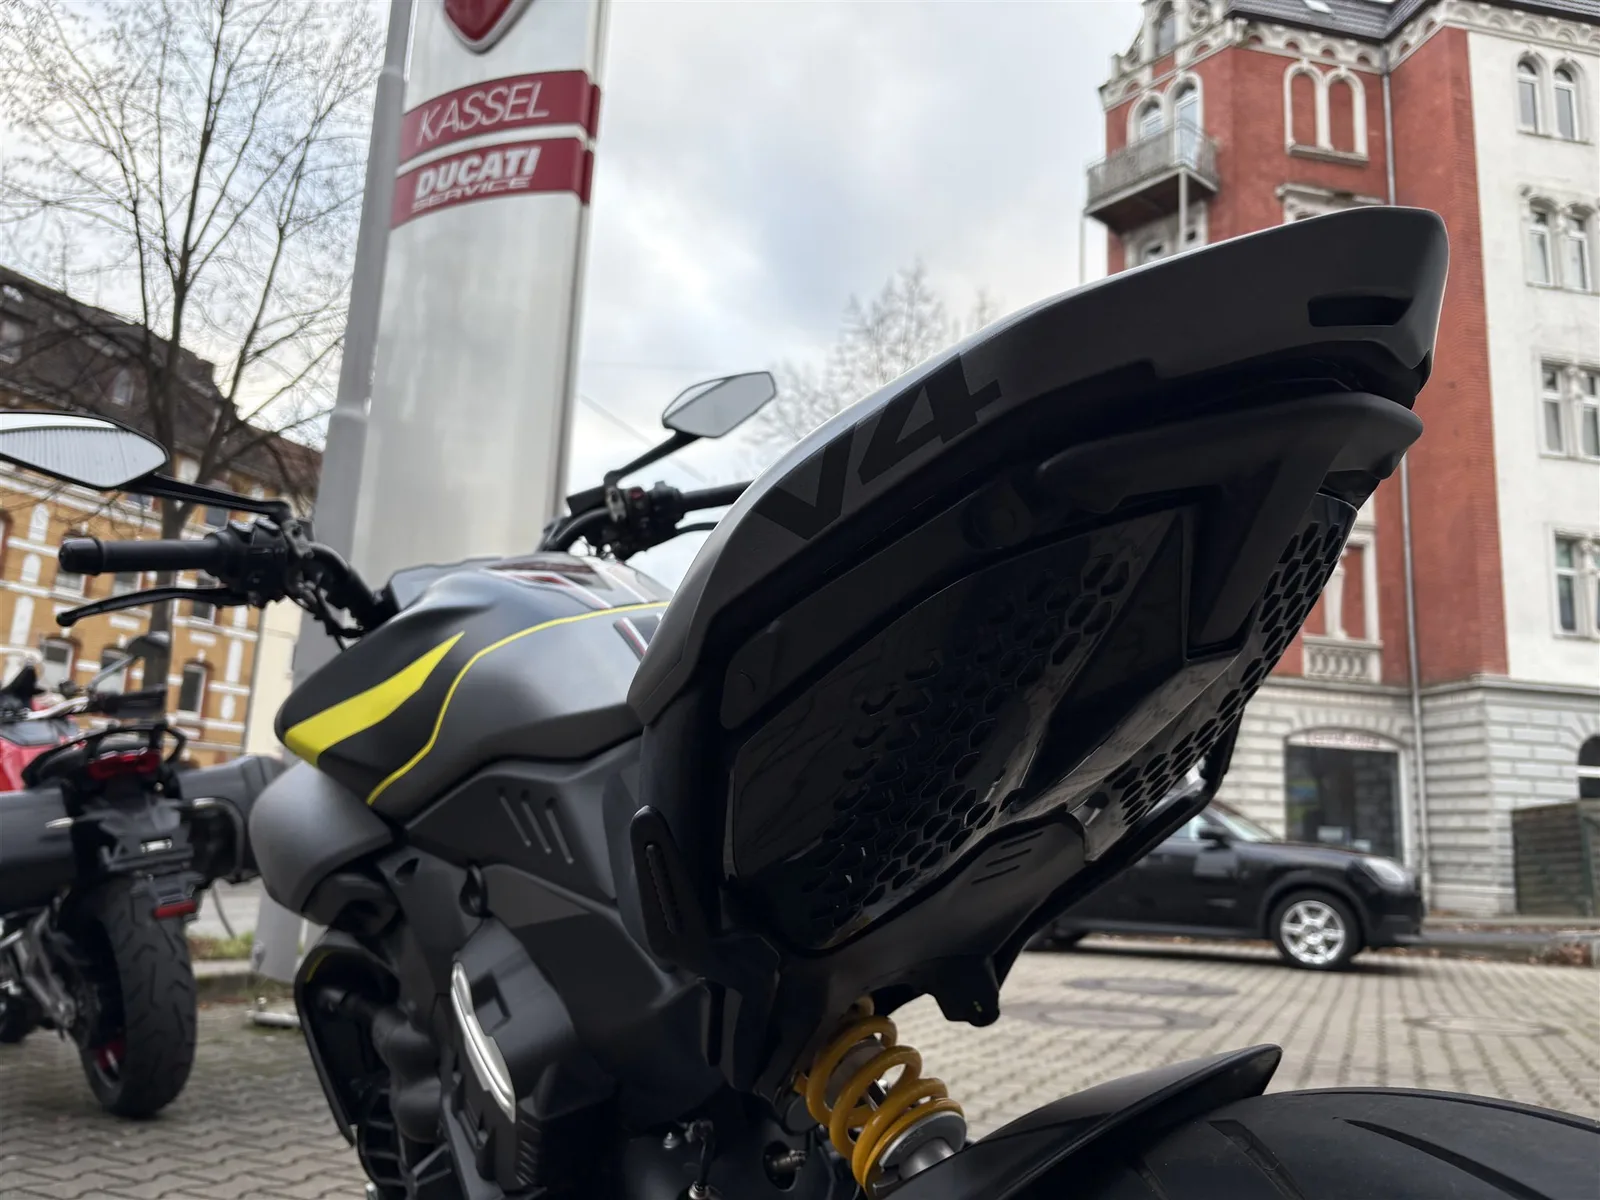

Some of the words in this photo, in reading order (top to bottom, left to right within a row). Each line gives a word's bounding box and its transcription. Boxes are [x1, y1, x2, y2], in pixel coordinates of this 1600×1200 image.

[416, 81, 549, 145] KASSEL
[412, 176, 532, 212] SERVICE
[415, 146, 541, 199] DUCATI
[750, 352, 1002, 541] V4
